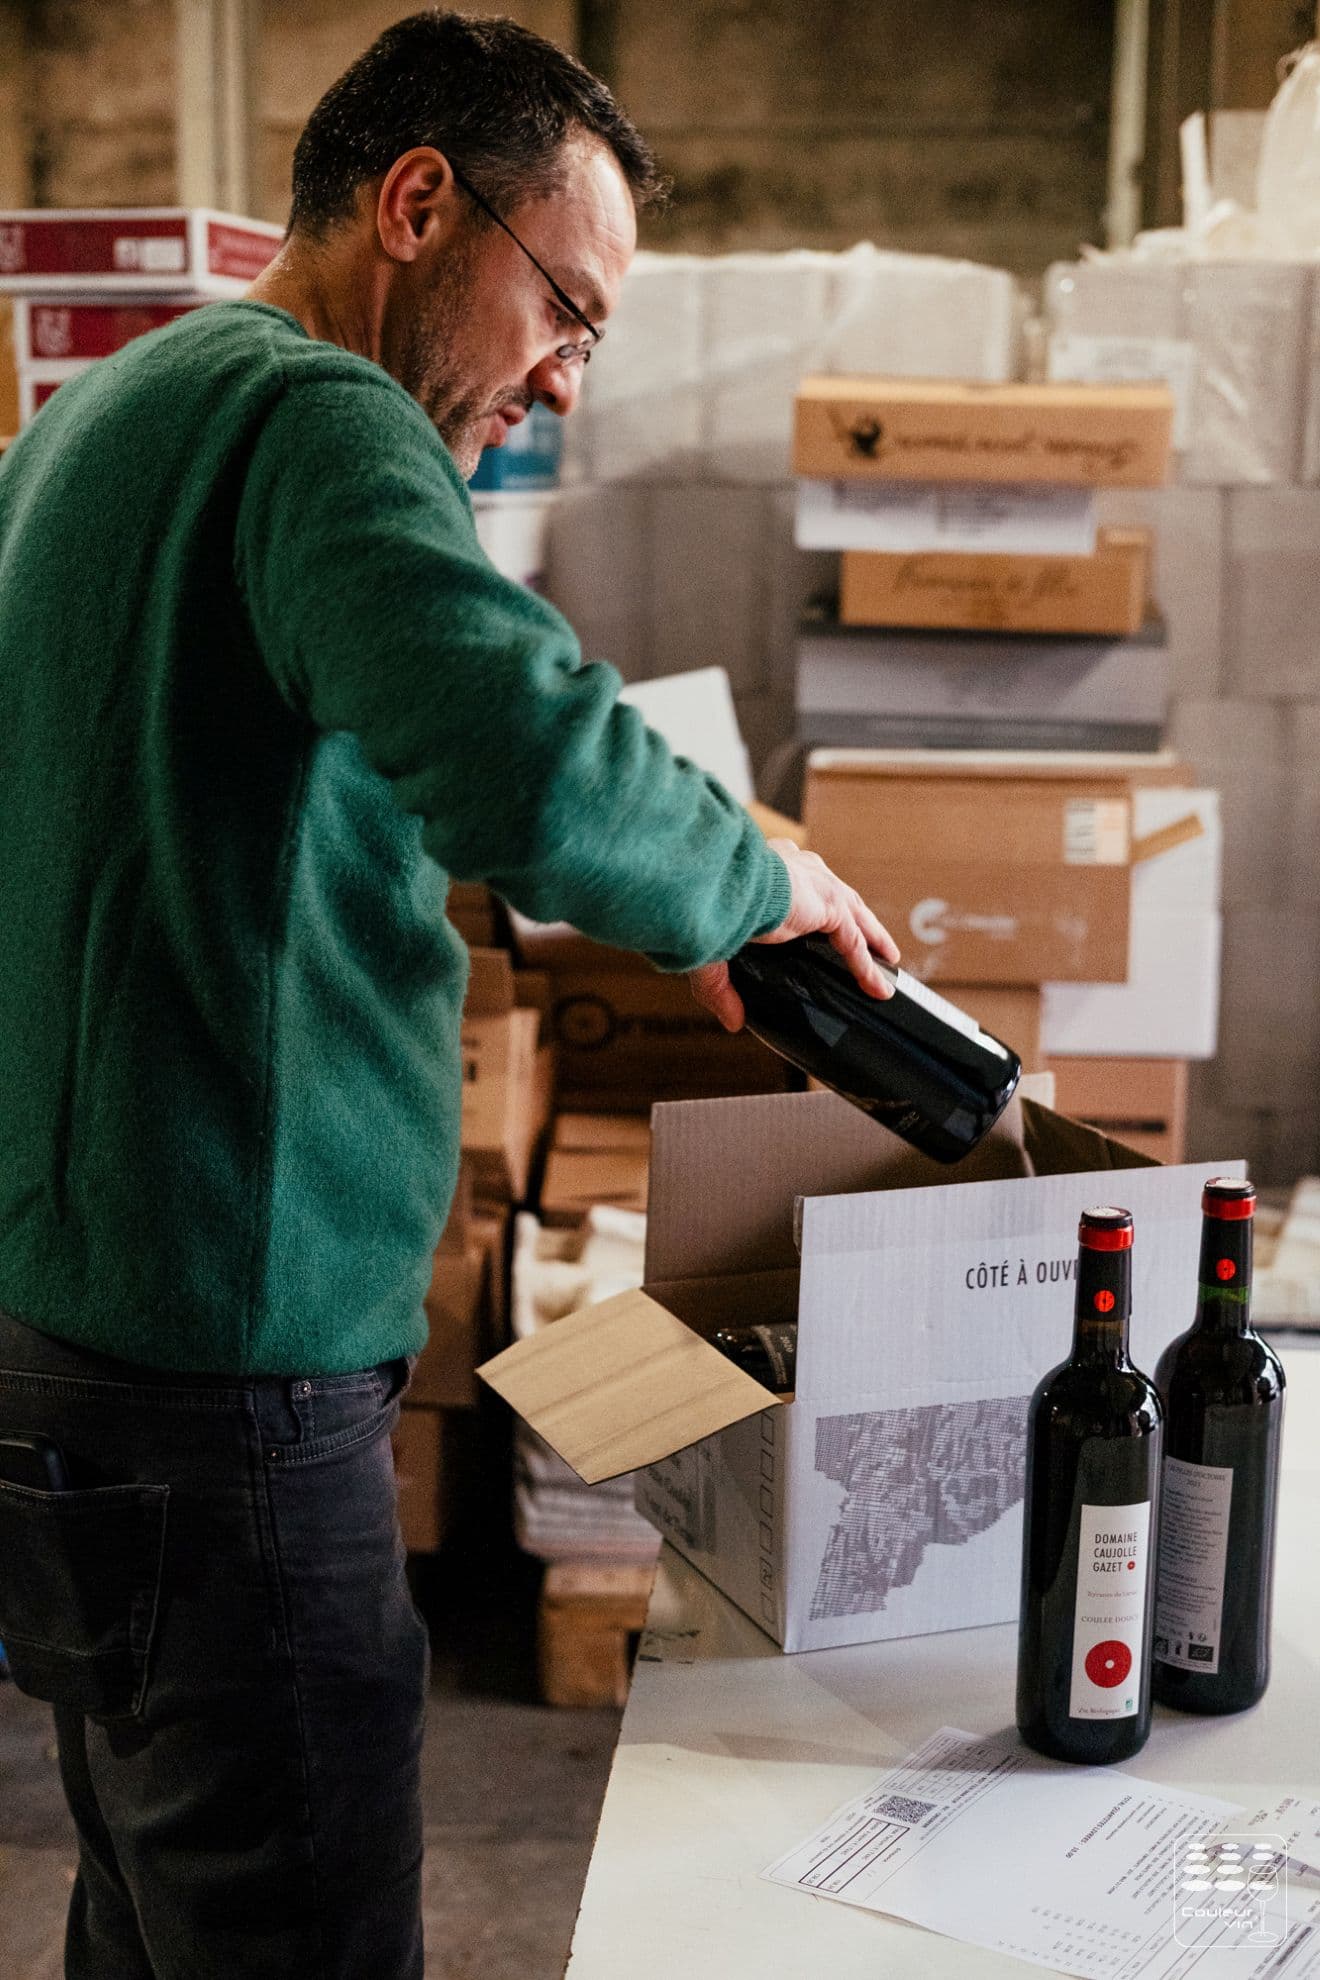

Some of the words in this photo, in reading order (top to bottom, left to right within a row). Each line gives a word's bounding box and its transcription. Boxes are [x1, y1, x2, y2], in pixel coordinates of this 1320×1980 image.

[965, 1260, 1009, 1289] CÔTÉ
[1016, 1258, 1027, 1285] À
[1094, 1532, 1138, 1544] DOMAINE
[1093, 1546, 1137, 1558] CAUJOLLE
[1092, 1561, 1122, 1572] GAZET
